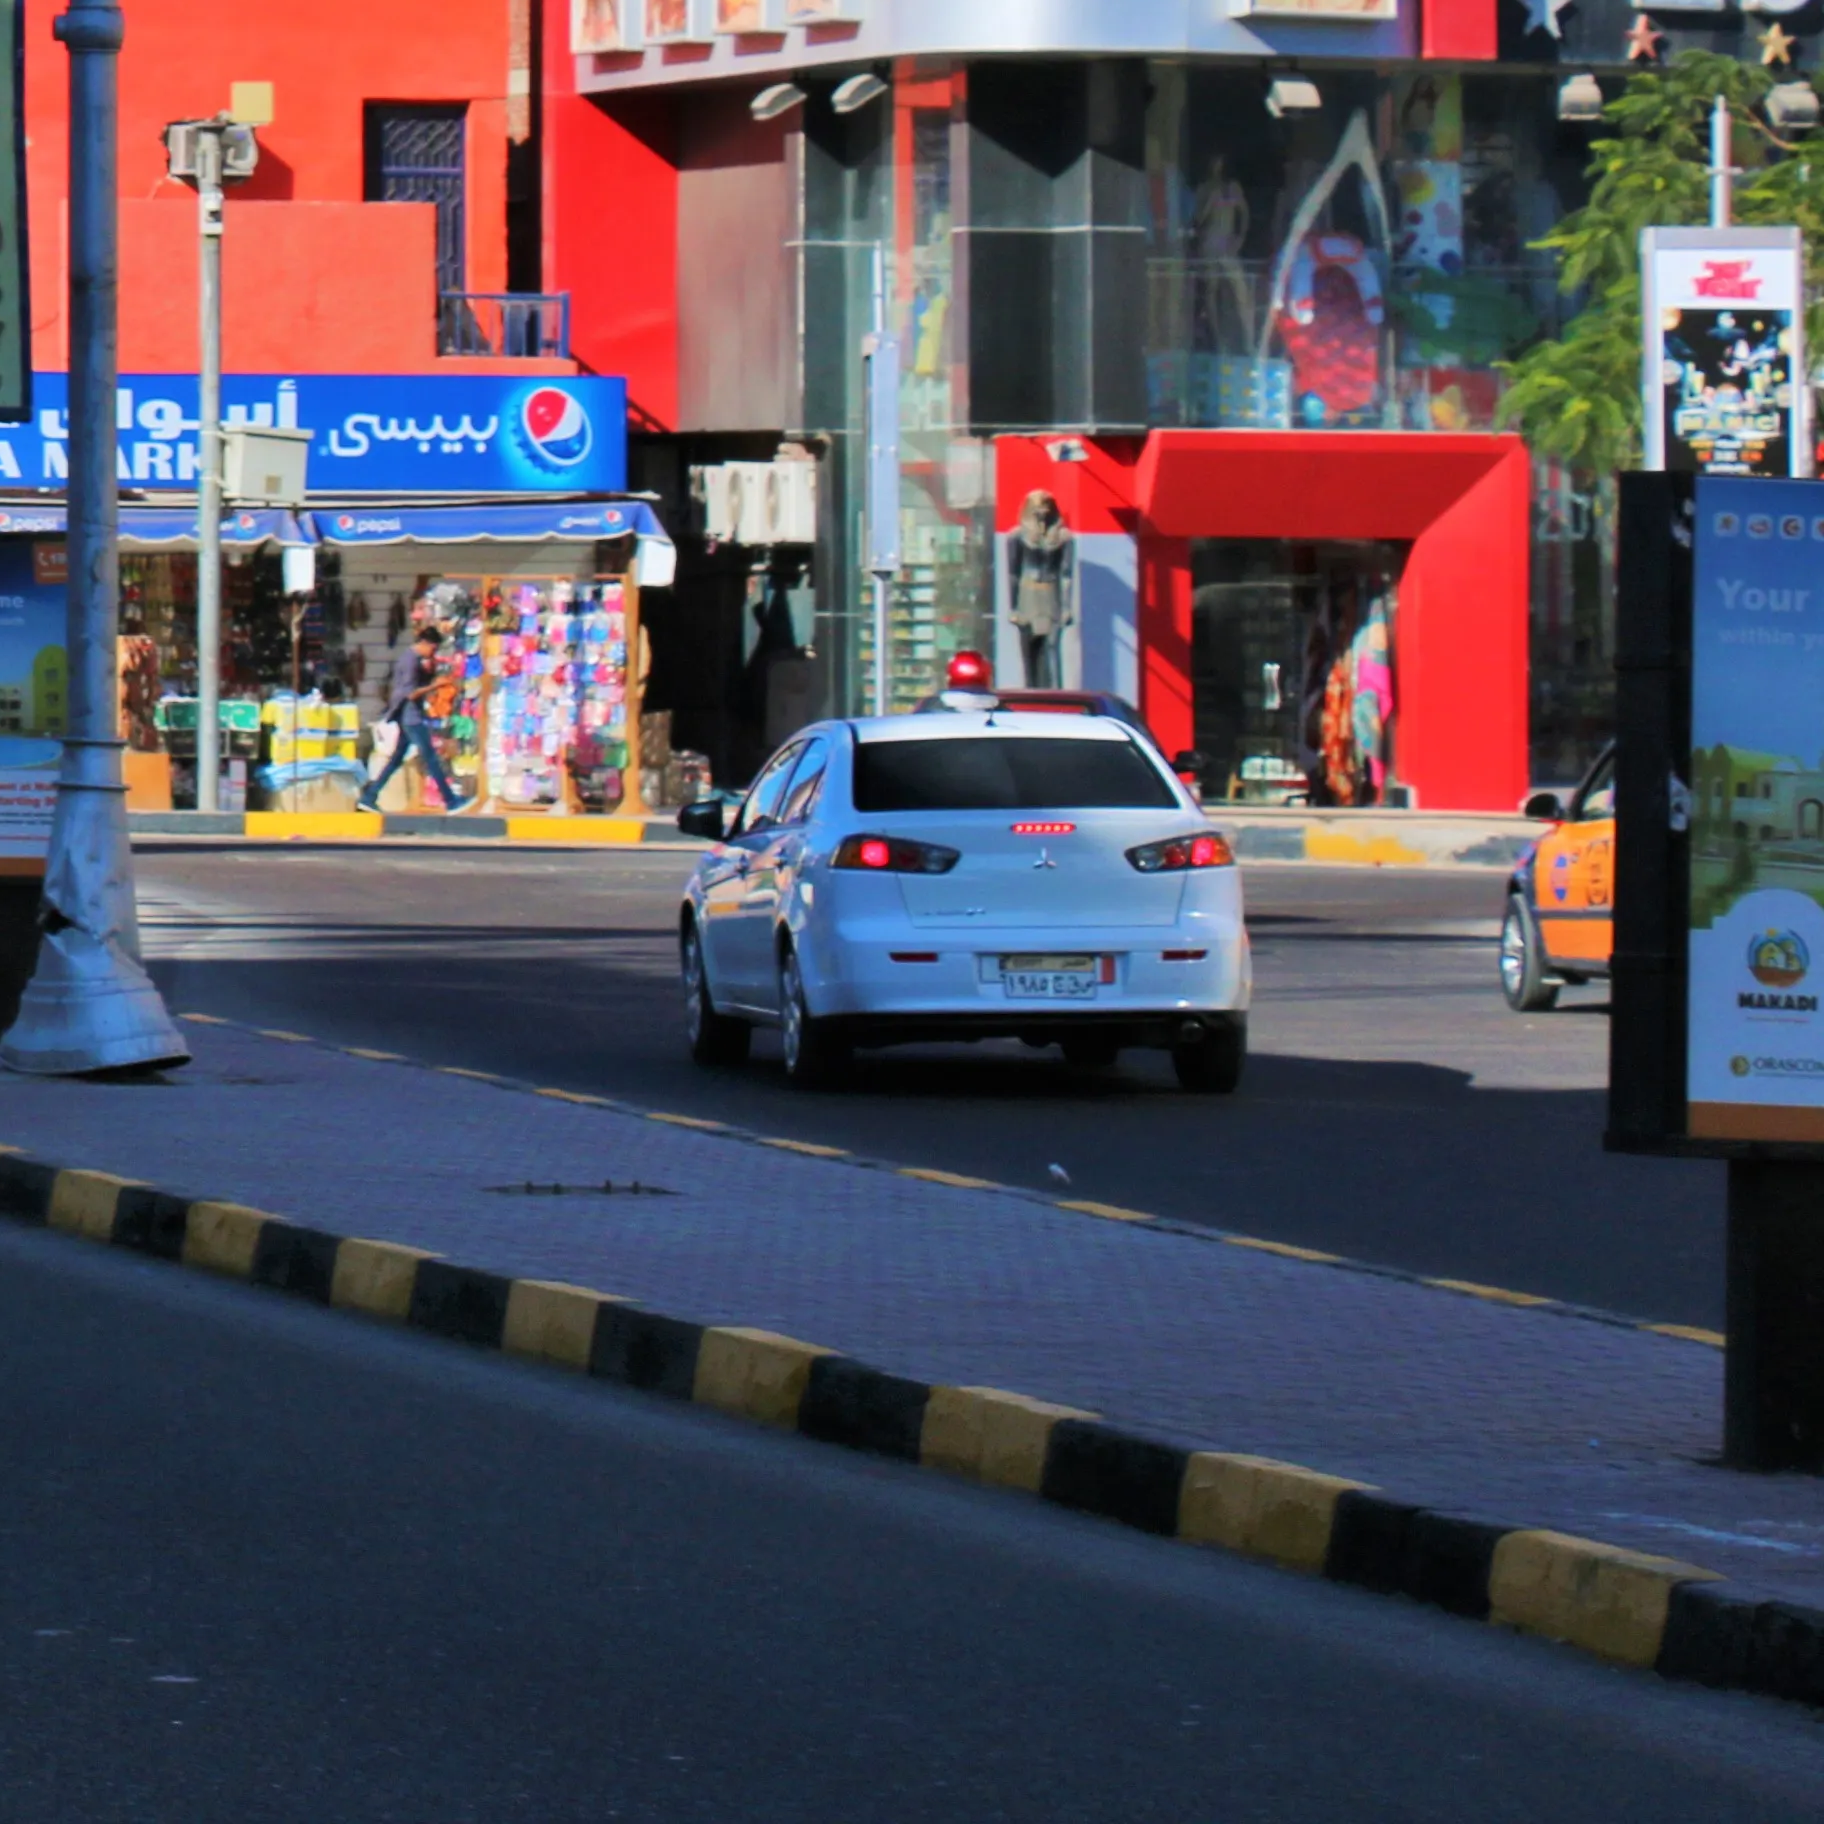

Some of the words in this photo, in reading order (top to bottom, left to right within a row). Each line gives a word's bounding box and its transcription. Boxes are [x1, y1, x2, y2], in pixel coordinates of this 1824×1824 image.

[326, 410, 500, 457] بيبسى
[357, 516, 402, 533] pepsi
[1716, 576, 1811, 613] Your
[1717, 626, 1796, 645] within
[1737, 992, 1819, 1012] MAKADI
